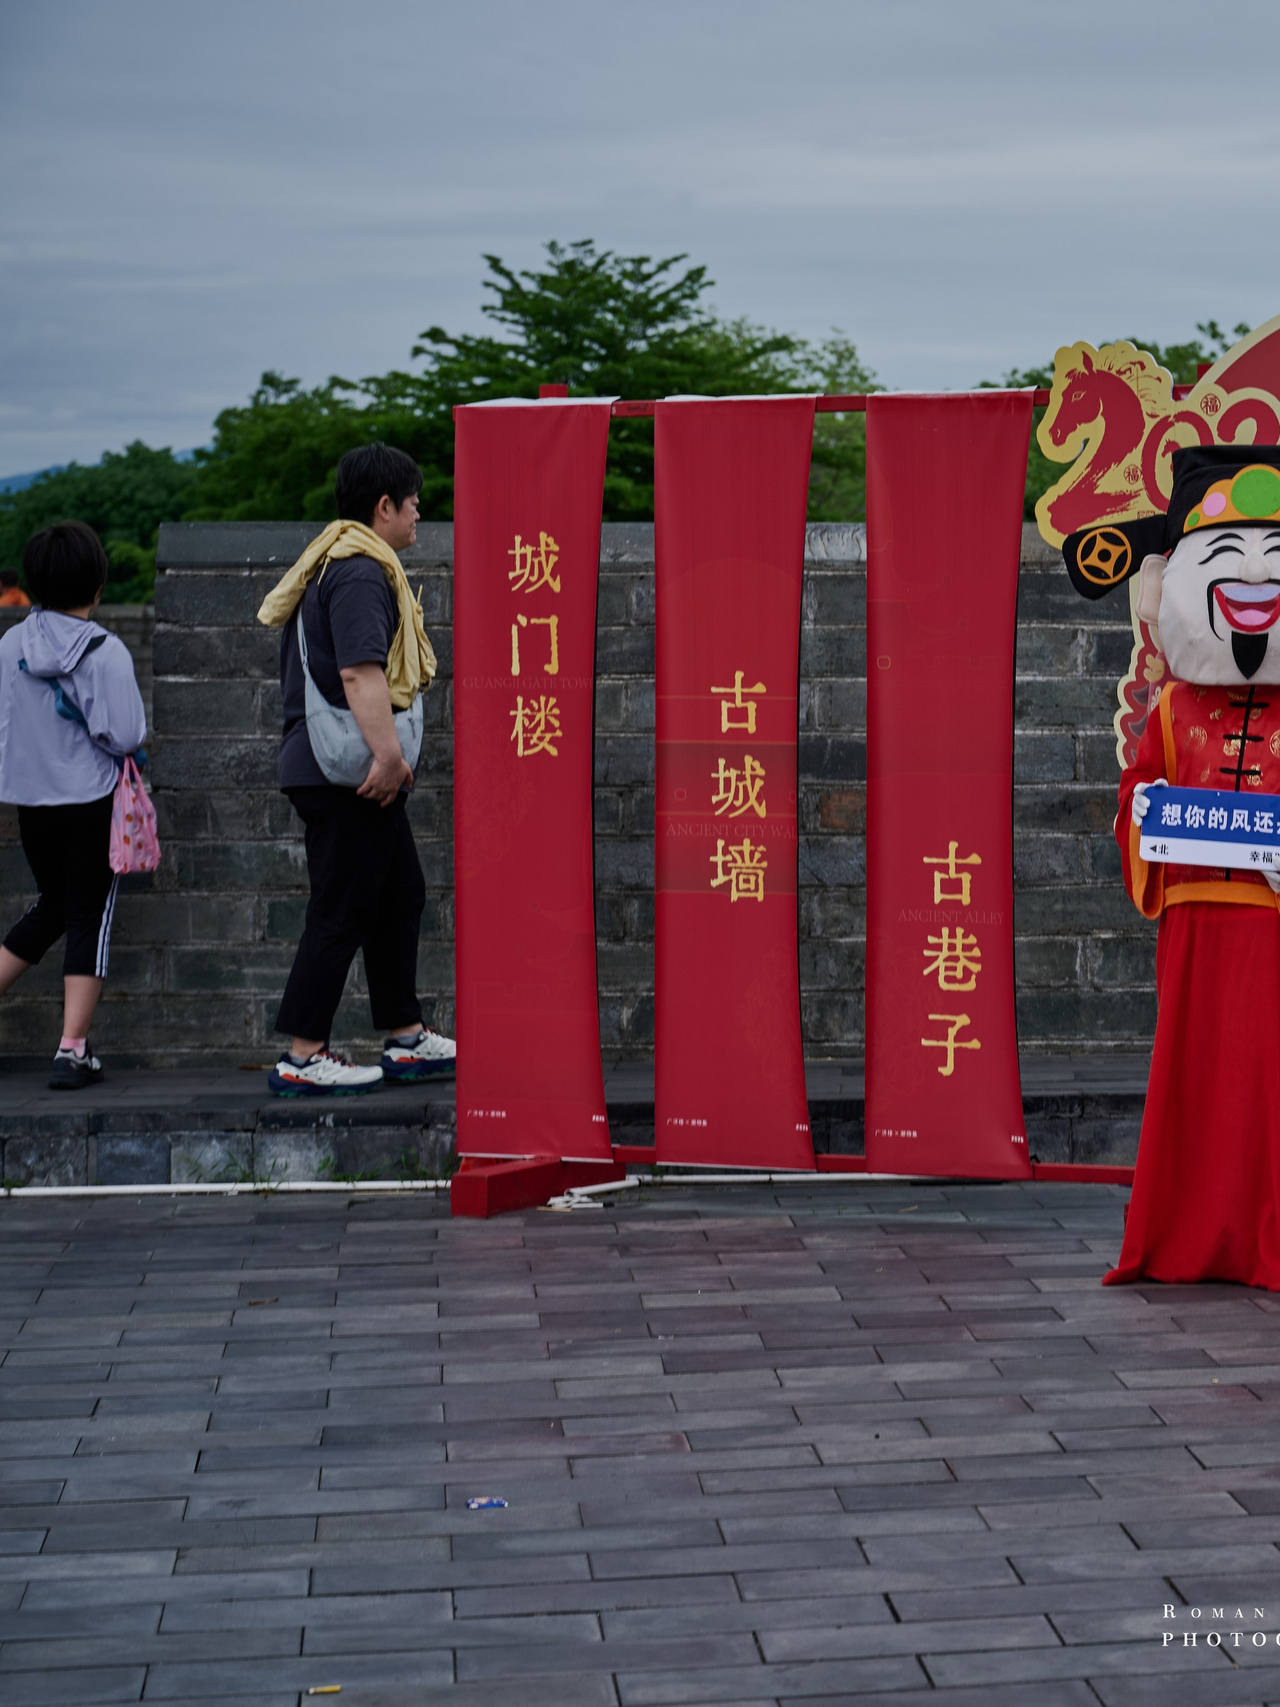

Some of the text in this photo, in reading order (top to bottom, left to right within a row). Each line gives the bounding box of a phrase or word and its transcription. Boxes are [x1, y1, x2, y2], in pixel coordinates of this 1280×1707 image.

[507, 531, 563, 757] 城门楼
[666, 823, 732, 837] ANCIENT
[734, 824, 767, 837] CITY
[709, 670, 768, 903] 古城墙
[898, 909, 1005, 924] ANCIENT ALLEY
[921, 840, 982, 1076] 古巷子
